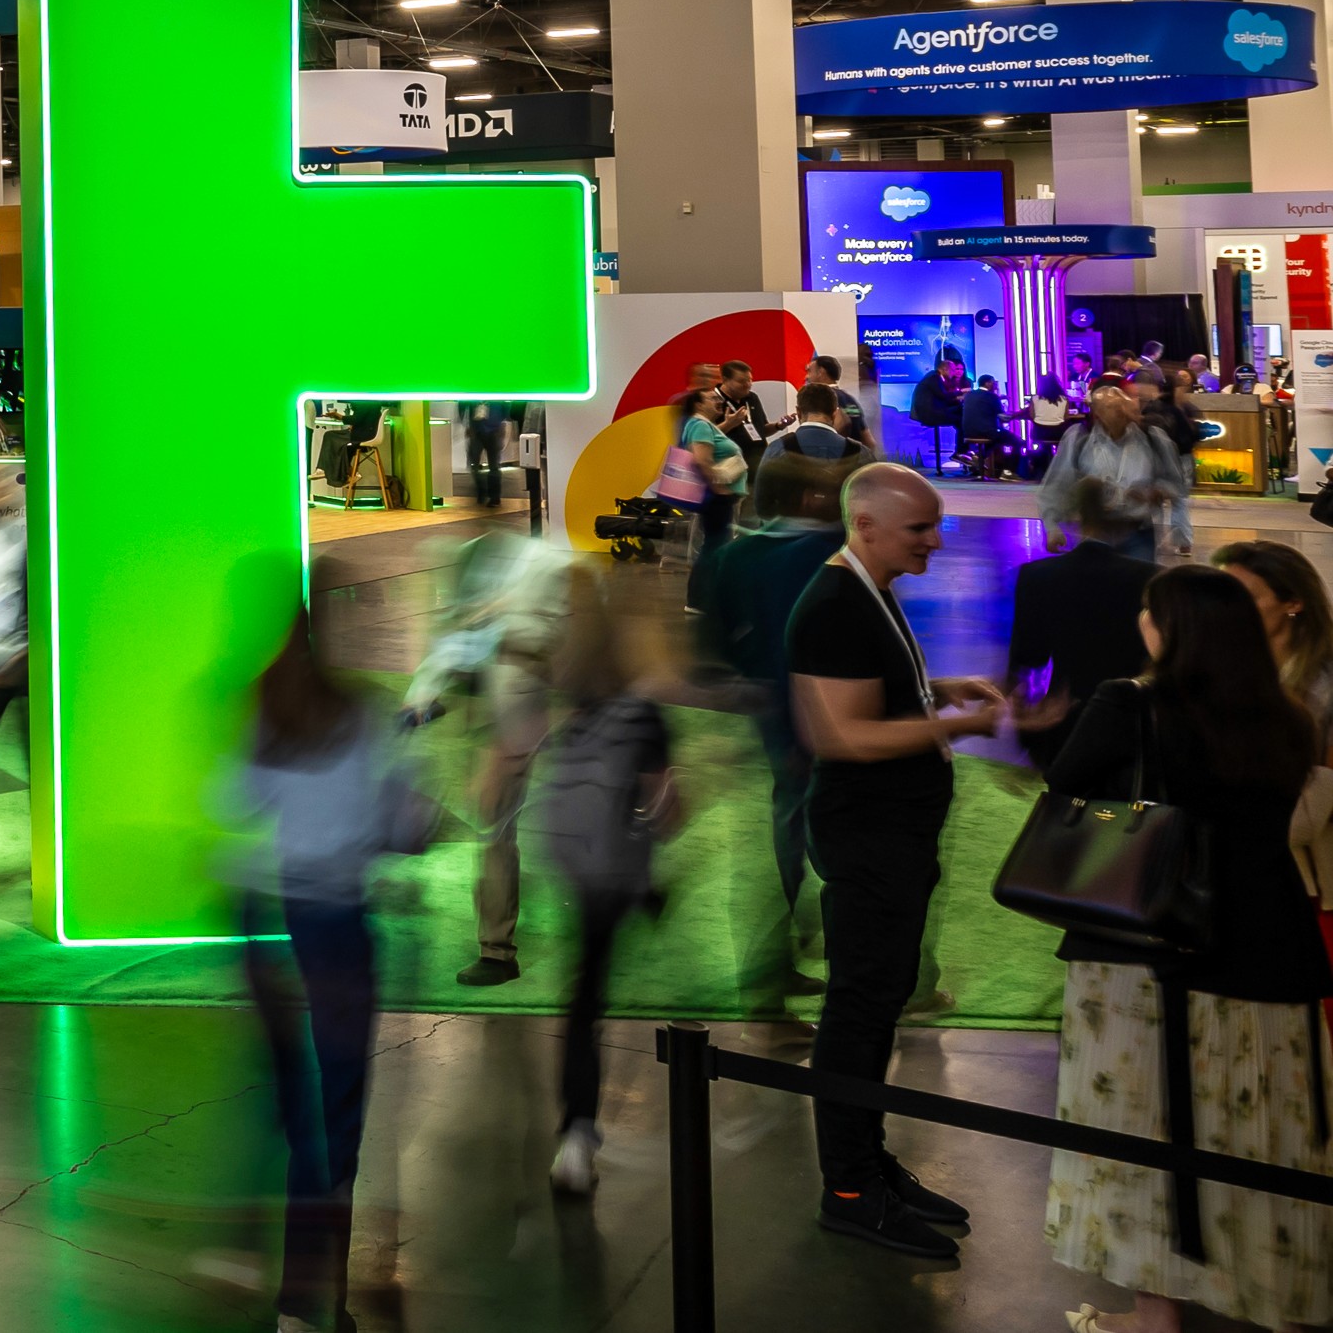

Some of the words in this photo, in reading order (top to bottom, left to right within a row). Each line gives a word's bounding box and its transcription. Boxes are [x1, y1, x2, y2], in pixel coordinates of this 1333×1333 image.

[893, 21, 1059, 55] Agentforce
[1233, 31, 1284, 49] salesforce
[824, 71, 863, 81] Humans
[865, 67, 888, 78] with
[889, 65, 931, 78] agents
[933, 64, 966, 75] drive
[968, 60, 1032, 72] customer
[1035, 56, 1091, 68] success
[1093, 53, 1154, 67] together.
[399, 113, 431, 130] TATA
[886, 197, 927, 208] salesforce
[844, 239, 876, 249] Make
[877, 240, 907, 250] every
[937, 238, 954, 246] Build
[976, 236, 1002, 245] agent
[1003, 235, 1013, 243] in
[1014, 235, 1024, 243] 15
[1025, 235, 1061, 243] minutes
[1062, 235, 1090, 244] today.
[837, 254, 853, 262] an
[854, 252, 914, 264] Agentforce
[1079, 313, 1087, 322] 2
[864, 329, 904, 338] Automate
